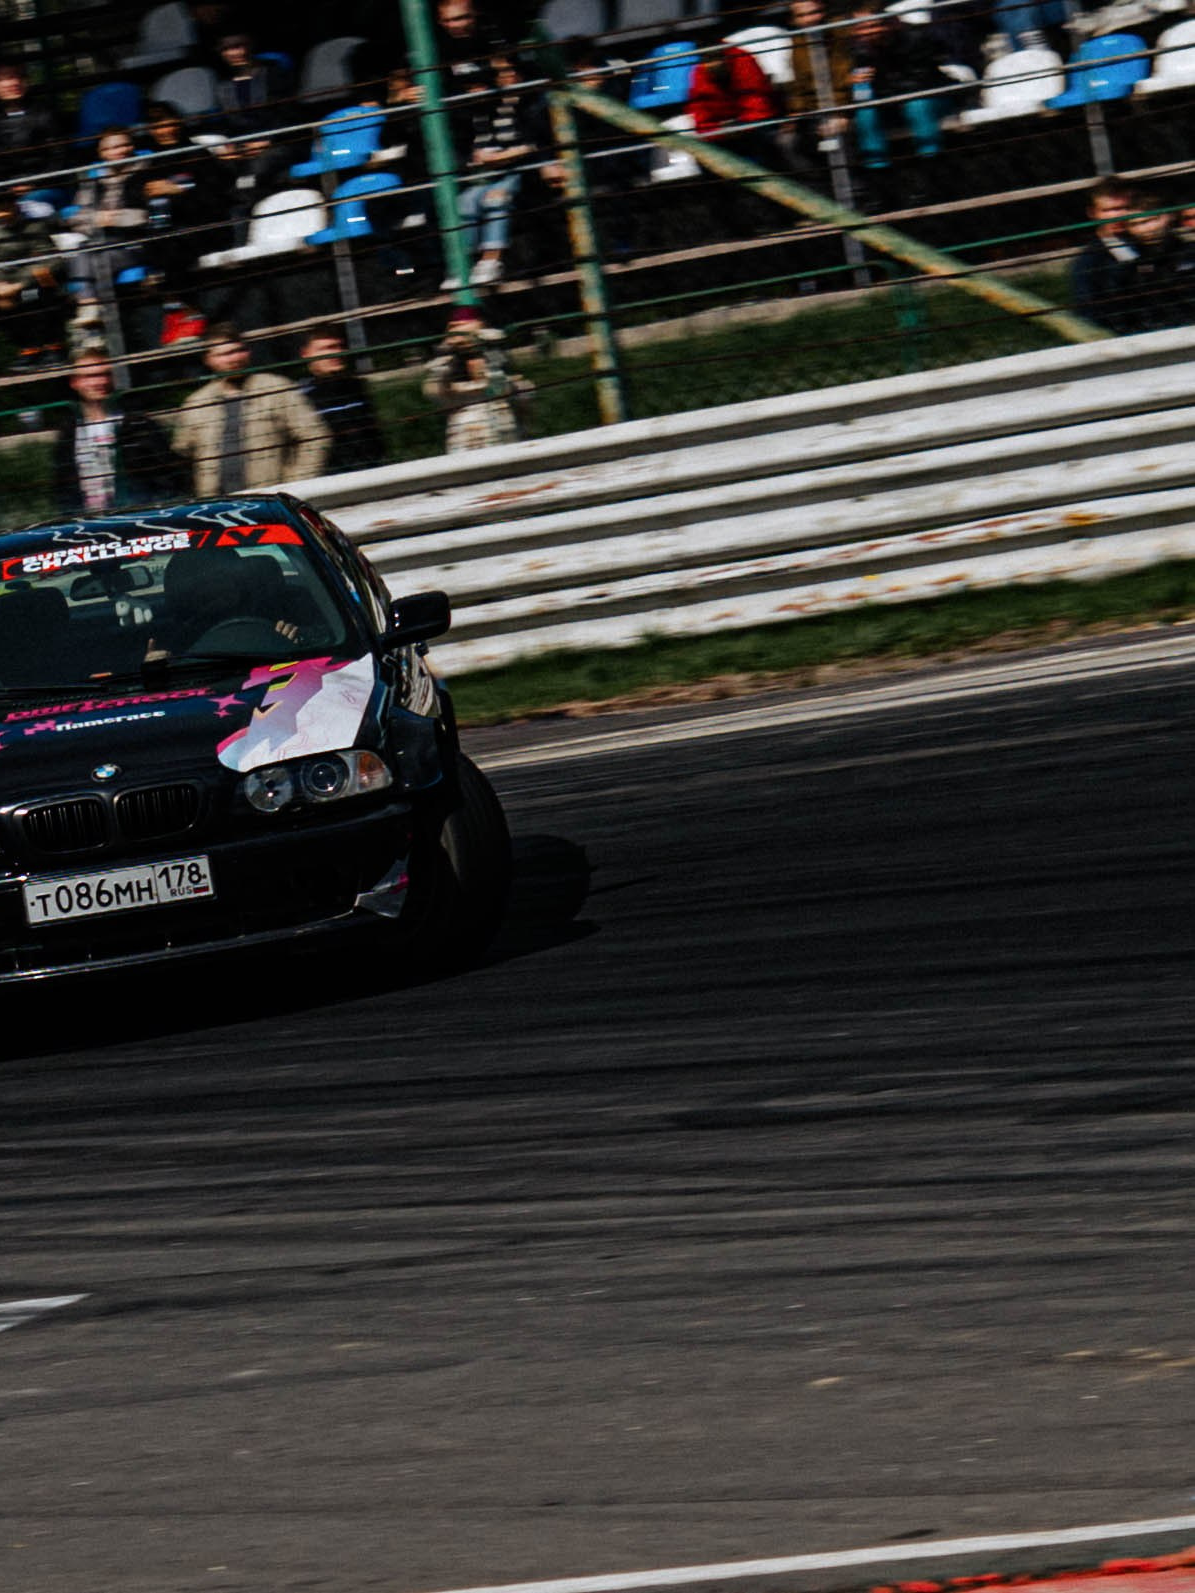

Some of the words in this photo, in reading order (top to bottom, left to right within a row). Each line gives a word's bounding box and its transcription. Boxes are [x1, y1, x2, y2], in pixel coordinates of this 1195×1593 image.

[22, 541, 122, 565] BURNING
[127, 532, 190, 547] TIRES
[22, 541, 191, 573] CHALLENGE
[157, 862, 201, 889] 178
[169, 886, 193, 897] RUS
